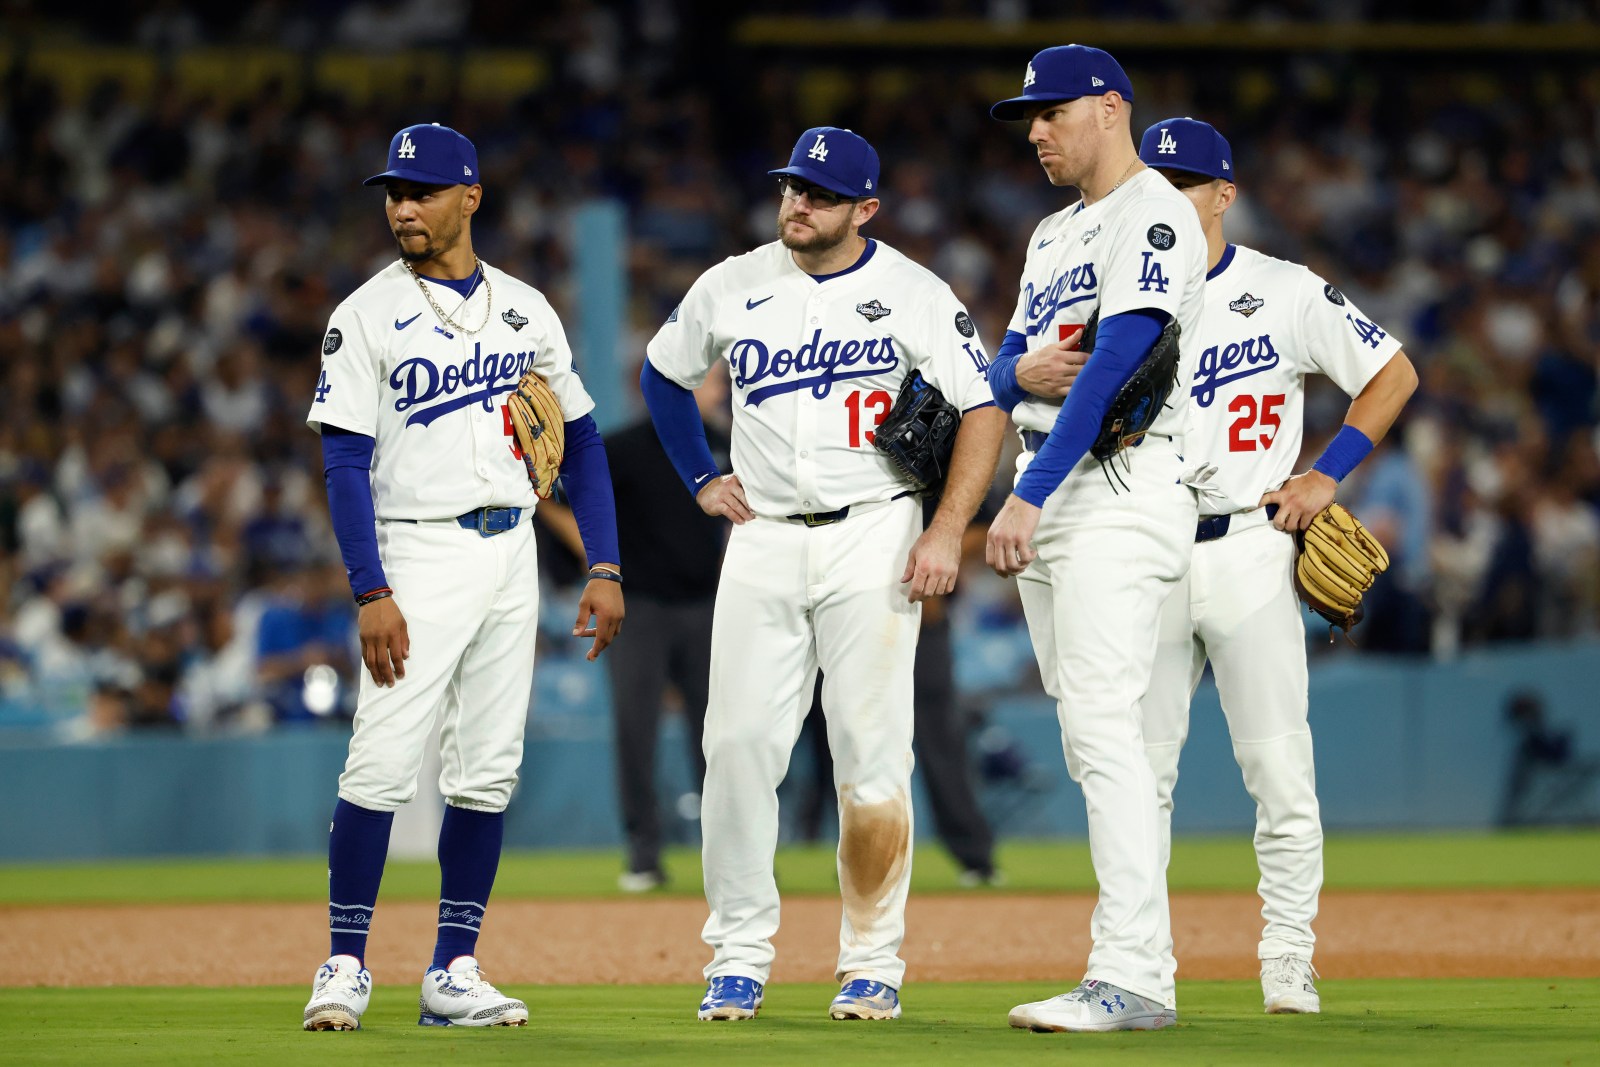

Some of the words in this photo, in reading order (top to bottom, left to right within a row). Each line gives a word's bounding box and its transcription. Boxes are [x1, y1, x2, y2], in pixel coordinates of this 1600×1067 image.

[398, 132, 416, 158] LA
[808, 134, 828, 162] LA
[1157, 128, 1177, 154] LA
[1152, 231, 1170, 248] 34
[1138, 251, 1169, 294] LA
[1346, 313, 1386, 349] LA
[730, 328, 899, 408] Dodgers
[962, 342, 991, 382] LA
[1190, 334, 1280, 408] gers
[315, 368, 332, 404] A
[844, 390, 893, 448] 13
[1228, 393, 1286, 453] 25
[440, 907, 453, 919] Los
